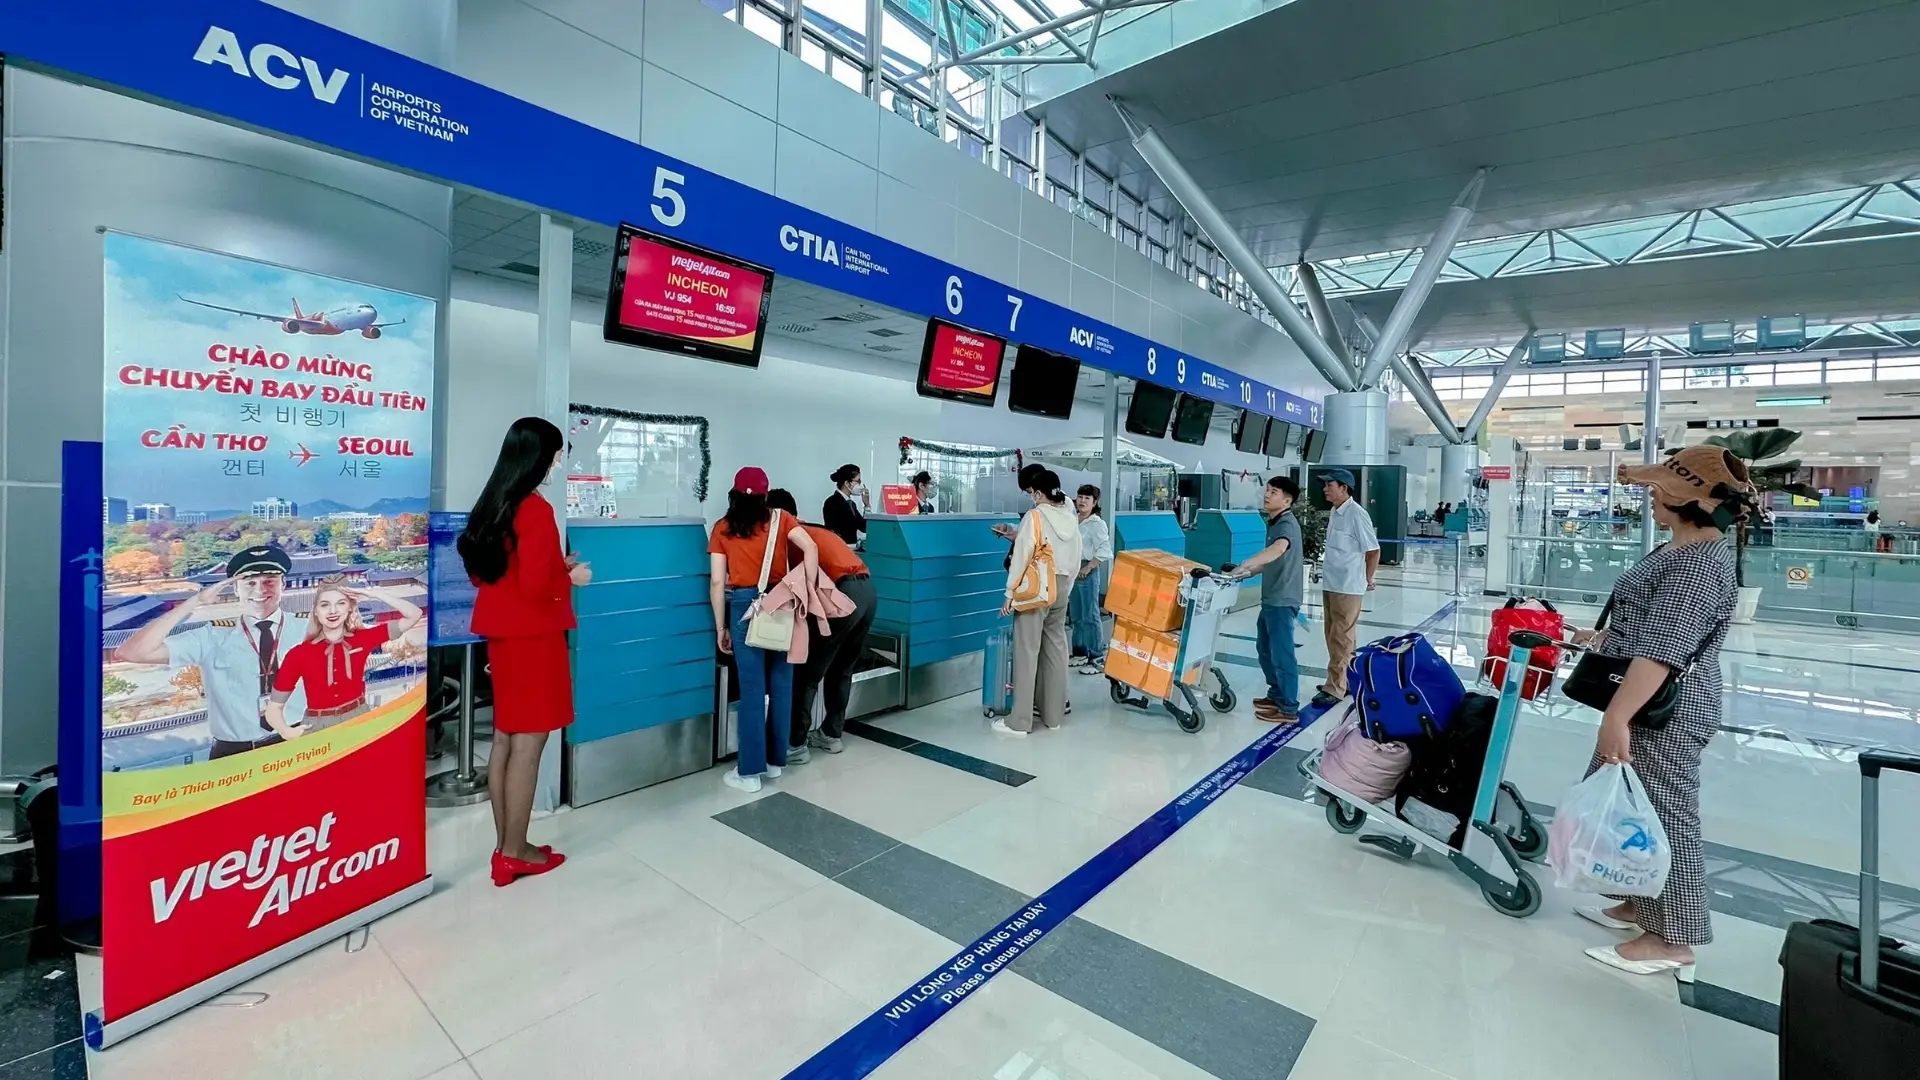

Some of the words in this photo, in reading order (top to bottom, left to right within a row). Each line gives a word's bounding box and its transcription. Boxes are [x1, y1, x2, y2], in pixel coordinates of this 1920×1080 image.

[193, 25, 350, 104] ACV
[371, 82, 441, 113] AIRPORTS
[370, 107, 391, 121] OF
[394, 114, 454, 142] VIETNAM
[371, 95, 469, 135] CORPORATION
[650, 166, 686, 227] 5
[779, 224, 839, 267] CTIA
[845, 246, 858, 256] CAN
[858, 250, 871, 260] THO
[844, 262, 870, 276] AIRPORT
[845, 254, 889, 275] INTERNATIONAL
[664, 290, 675, 300] VJ
[676, 293, 692, 304] 954
[667, 272, 728, 299] INCHEON
[945, 275, 963, 315] 6
[676, 315, 683, 323] 15
[687, 309, 695, 317] 15
[715, 302, 736, 315] 16:50
[1007, 294, 1023, 332] 7
[1069, 326, 1094, 349] ACV
[207, 343, 290, 371] CHÀO
[296, 353, 373, 383] MỪNG
[952, 345, 983, 361] INCHEON
[1147, 347, 1156, 375] 8
[1177, 358, 1186, 384] 9
[1201, 371, 1217, 389] CTIA
[118, 364, 253, 396] CHUYẾN
[260, 379, 316, 401] BAY
[321, 381, 374, 408] ĐẦU
[378, 390, 426, 412] TIÊN
[1240, 382, 1251, 404] 10
[1266, 390, 1276, 411] 11
[240, 402, 262, 424] 첫
[276, 405, 346, 428] 비행기
[1310, 406, 1318, 425] 12
[140, 423, 206, 450] CẦN
[212, 433, 268, 452] THƠ
[337, 435, 414, 457] SEOUL
[339, 459, 382, 478] 서울
[262, 757, 294, 775] Enjoy
[296, 742, 332, 764] Flying!
[132, 792, 161, 808] Bay
[165, 787, 178, 801] là
[217, 768, 252, 790] ngay!
[247, 837, 400, 929] Air.com
[1592, 862, 1636, 886] PHÚC
[885, 998, 917, 1020] VUI
[912, 971, 953, 1002] LÒNG
[949, 953, 976, 975] XẾP
[974, 930, 1011, 957] HÀNG
[1005, 916, 1028, 934] TẠI
[1024, 902, 1048, 922] ĐÂY
[940, 972, 985, 1005] Please
[981, 945, 1019, 974] Queue
[1013, 927, 1042, 949] Here
